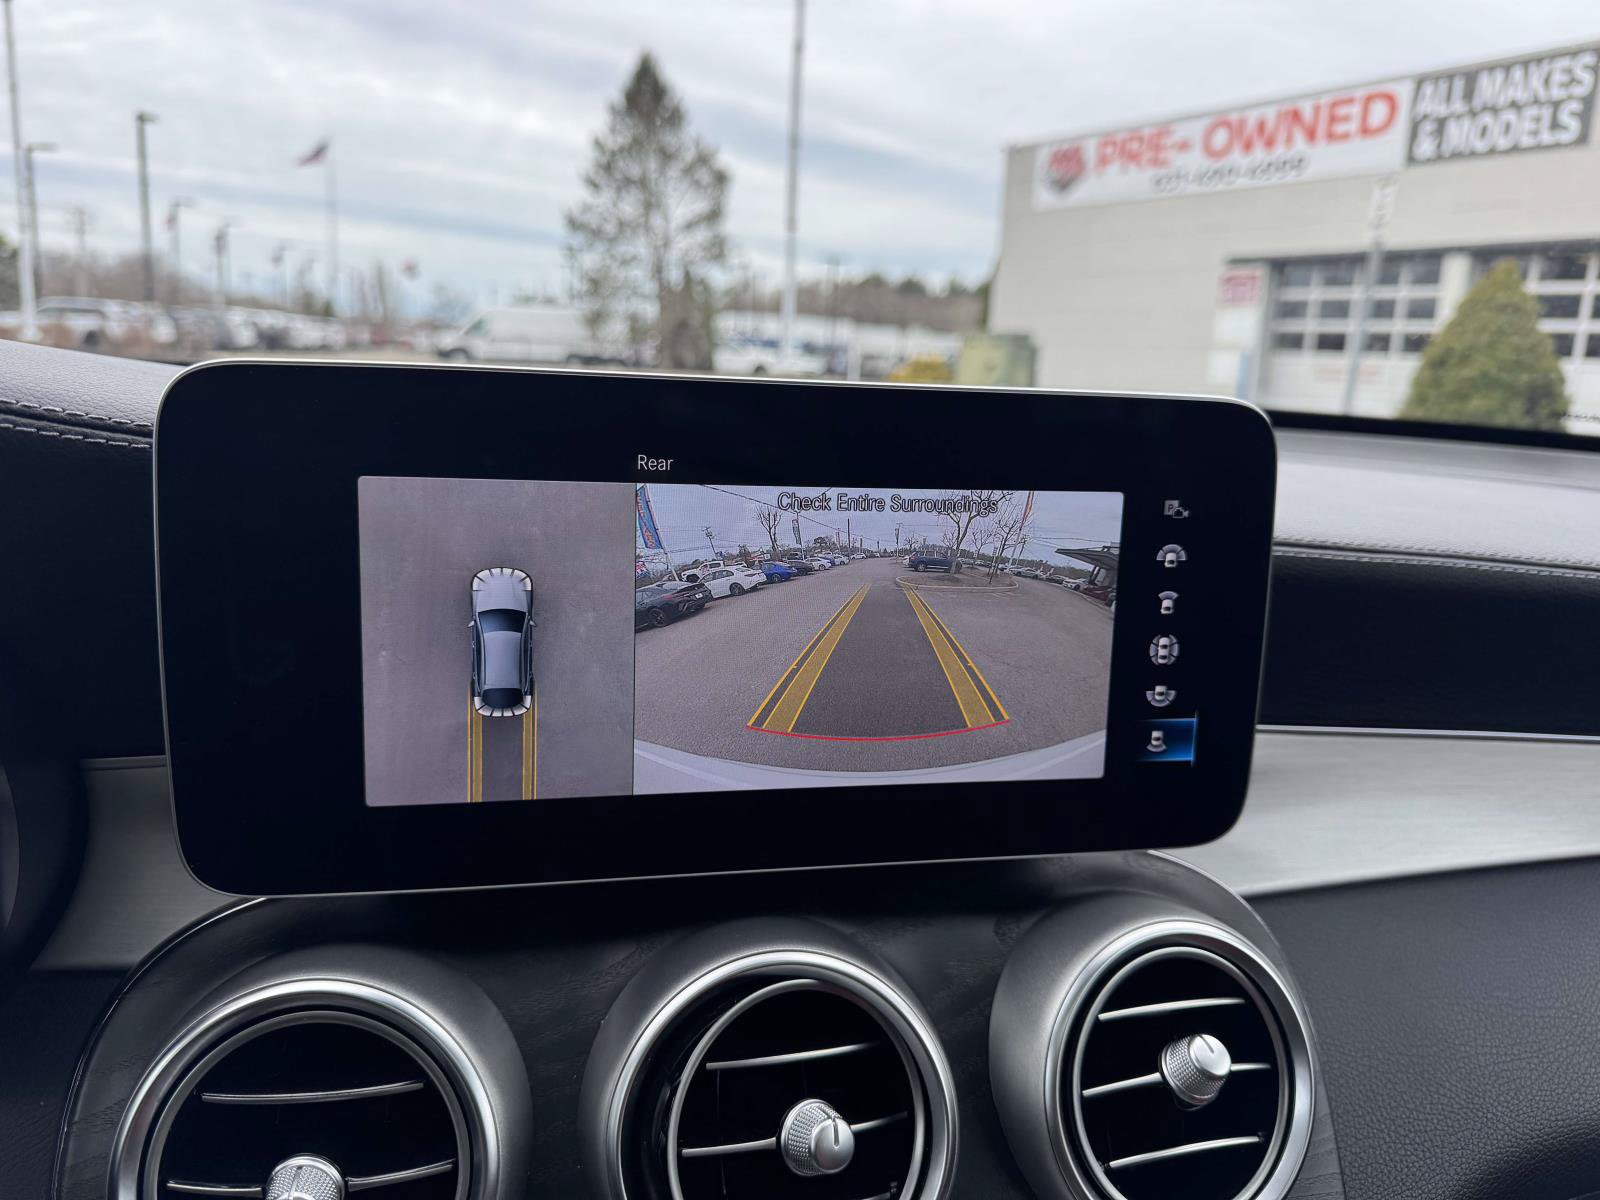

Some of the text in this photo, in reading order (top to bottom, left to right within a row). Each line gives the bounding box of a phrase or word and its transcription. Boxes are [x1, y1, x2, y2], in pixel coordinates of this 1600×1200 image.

[1413, 51, 1598, 121] ALL MAKES
[1202, 91, 1399, 161] OWNED
[1411, 101, 1584, 162] & MODELS
[637, 454, 674, 471] Rear
[777, 491, 999, 518] Check Entire Surroundings
